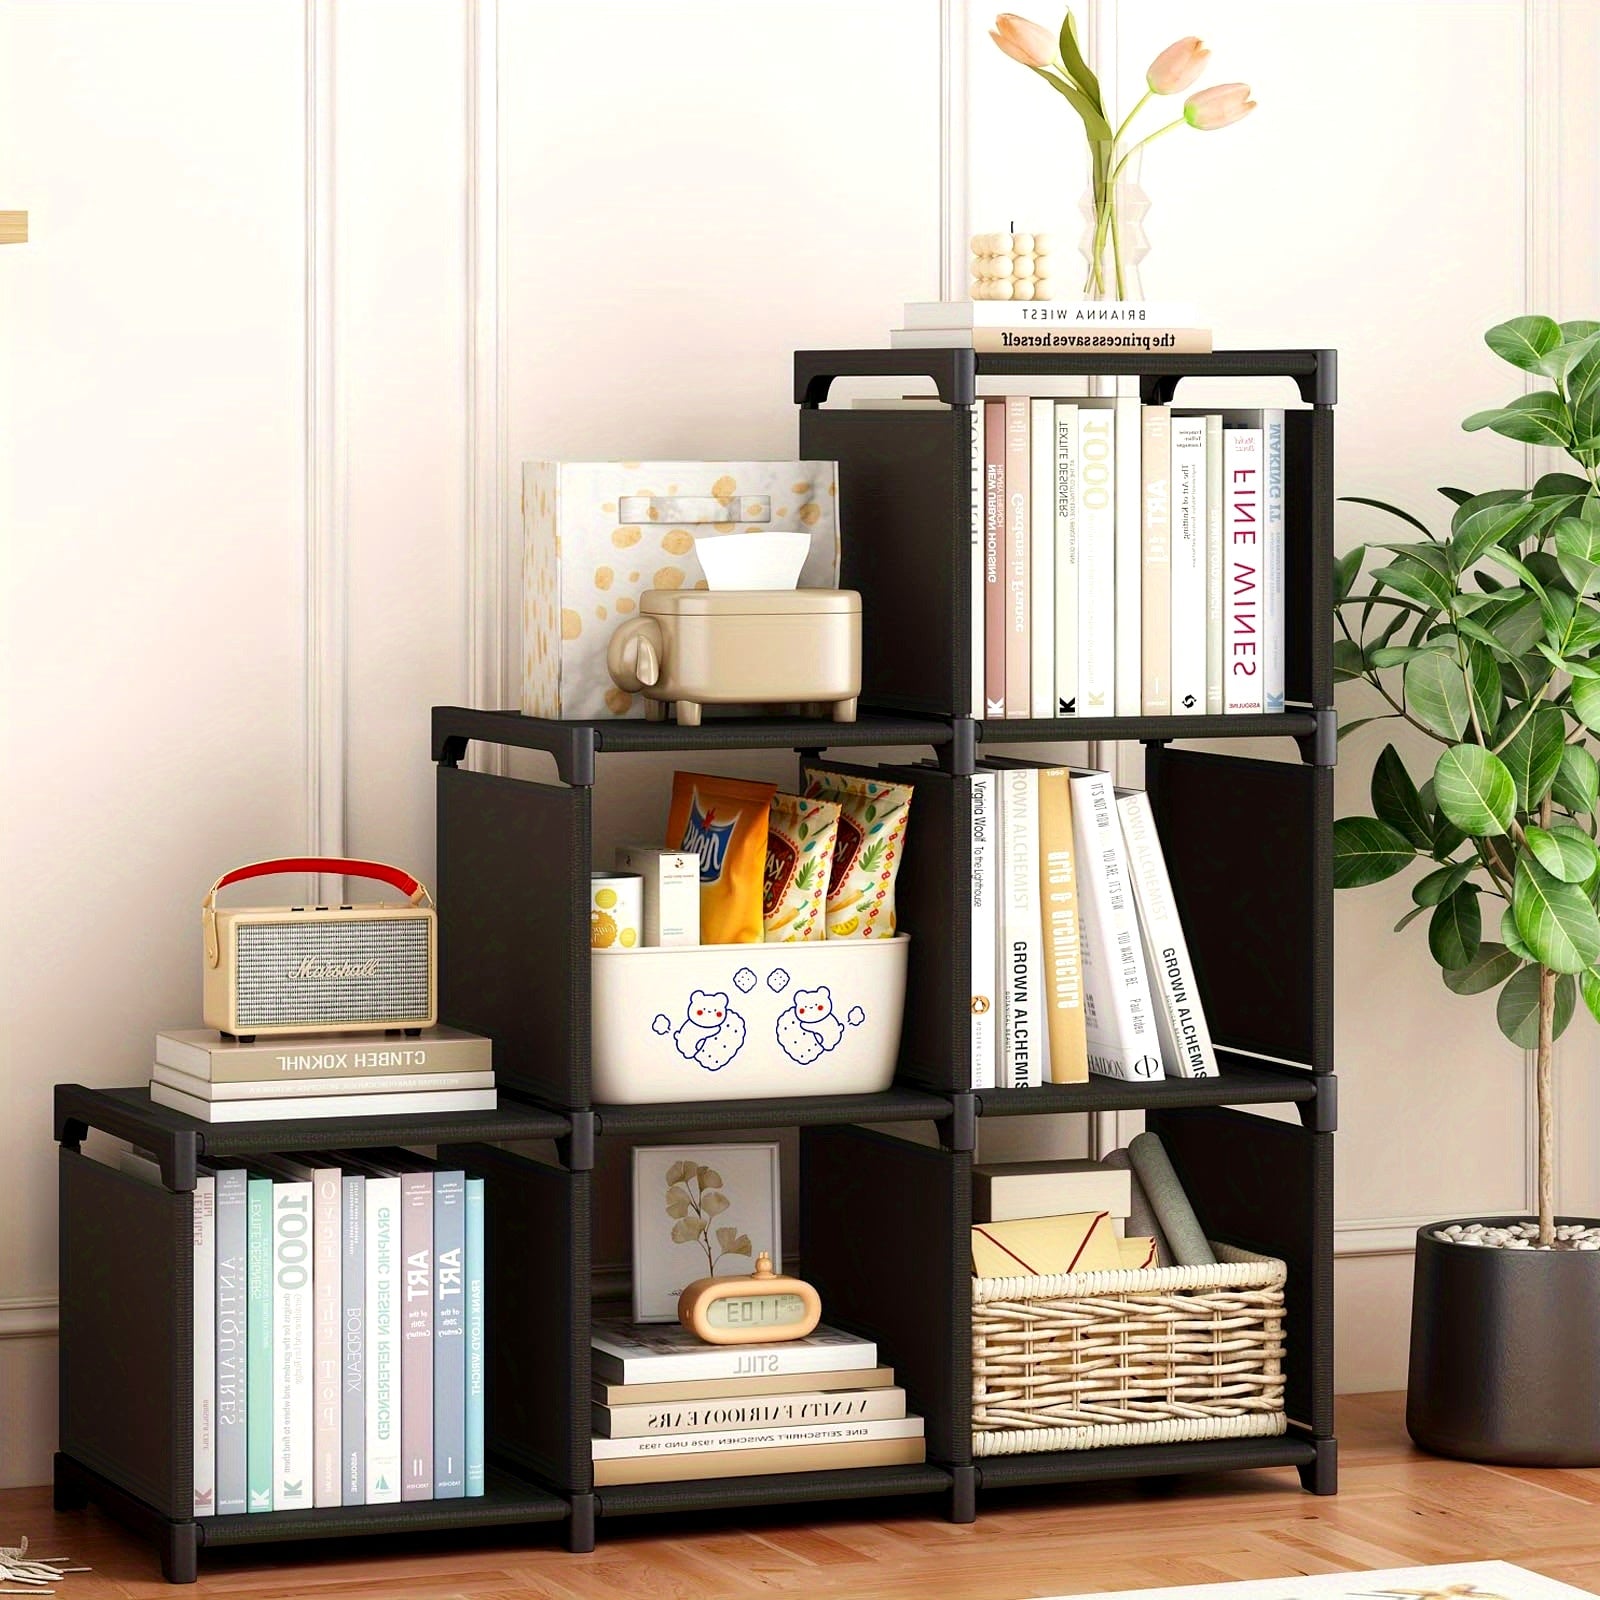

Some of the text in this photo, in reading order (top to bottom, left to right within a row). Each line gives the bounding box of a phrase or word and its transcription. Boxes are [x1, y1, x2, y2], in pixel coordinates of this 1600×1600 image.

[1091, 782, 1104, 796] IT'S
[1093, 797, 1107, 811] NOT
[1096, 812, 1110, 828] HOW
[971, 781, 987, 908] Virginia Woolf To the Lighthouse
[1102, 848, 1116, 862] YOU
[1012, 824, 1029, 912] ALCHEMIST
[1047, 851, 1072, 884] arts
[1108, 880, 1122, 893] IT'S
[1111, 895, 1124, 911] HOW
[1117, 931, 1130, 945] YOU
[1052, 909, 1081, 1008] architecture
[1120, 946, 1135, 965] WANT
[288, 955, 380, 979] Marshall
[1013, 941, 1028, 1003] GROWN
[1123, 966, 1136, 976] TO
[1162, 947, 1187, 1003] GROWN
[1129, 998, 1146, 1035] Paul Arden
